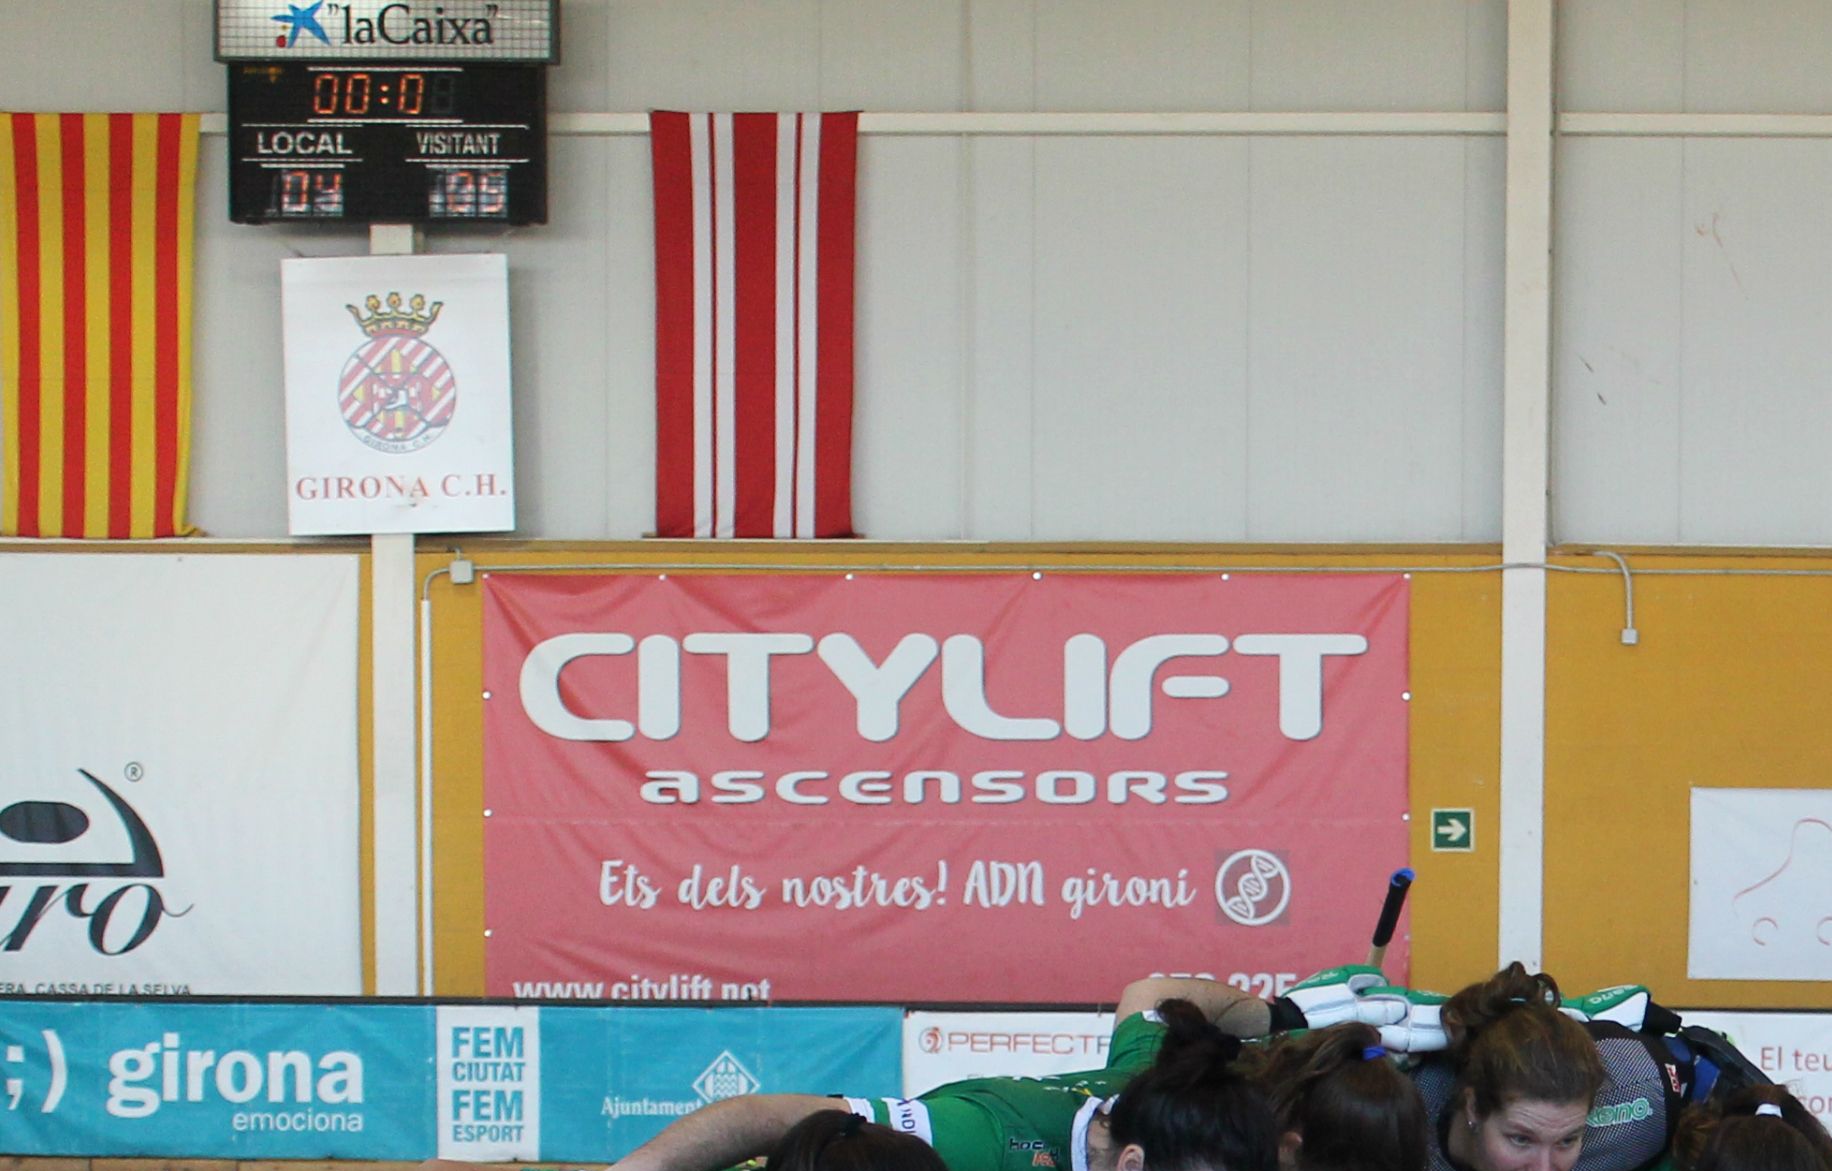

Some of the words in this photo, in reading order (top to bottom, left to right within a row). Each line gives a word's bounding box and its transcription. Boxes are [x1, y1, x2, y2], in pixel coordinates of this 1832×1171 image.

[256, 130, 353, 155] LOCAL
[415, 131, 501, 156] VISITANT
[295, 475, 430, 500] GIRONA
[441, 473, 507, 497] C.H.
[519, 632, 1368, 743] CITYLIFT
[640, 769, 1230, 805] ascensors
[599, 860, 661, 911] Ets
[678, 861, 764, 910] dels
[781, 860, 949, 909] nostres!
[963, 860, 1045, 909] ADN
[1061, 866, 1197, 920] gironí
[451, 1026, 525, 1060] FEM
[451, 1062, 527, 1083] CIUTAT
[1760, 1046, 1782, 1072] El
[105, 1032, 365, 1119] girona
[451, 1089, 524, 1121] FEM
[231, 1109, 364, 1133] emociona
[451, 1123, 525, 1145] ESPORT
